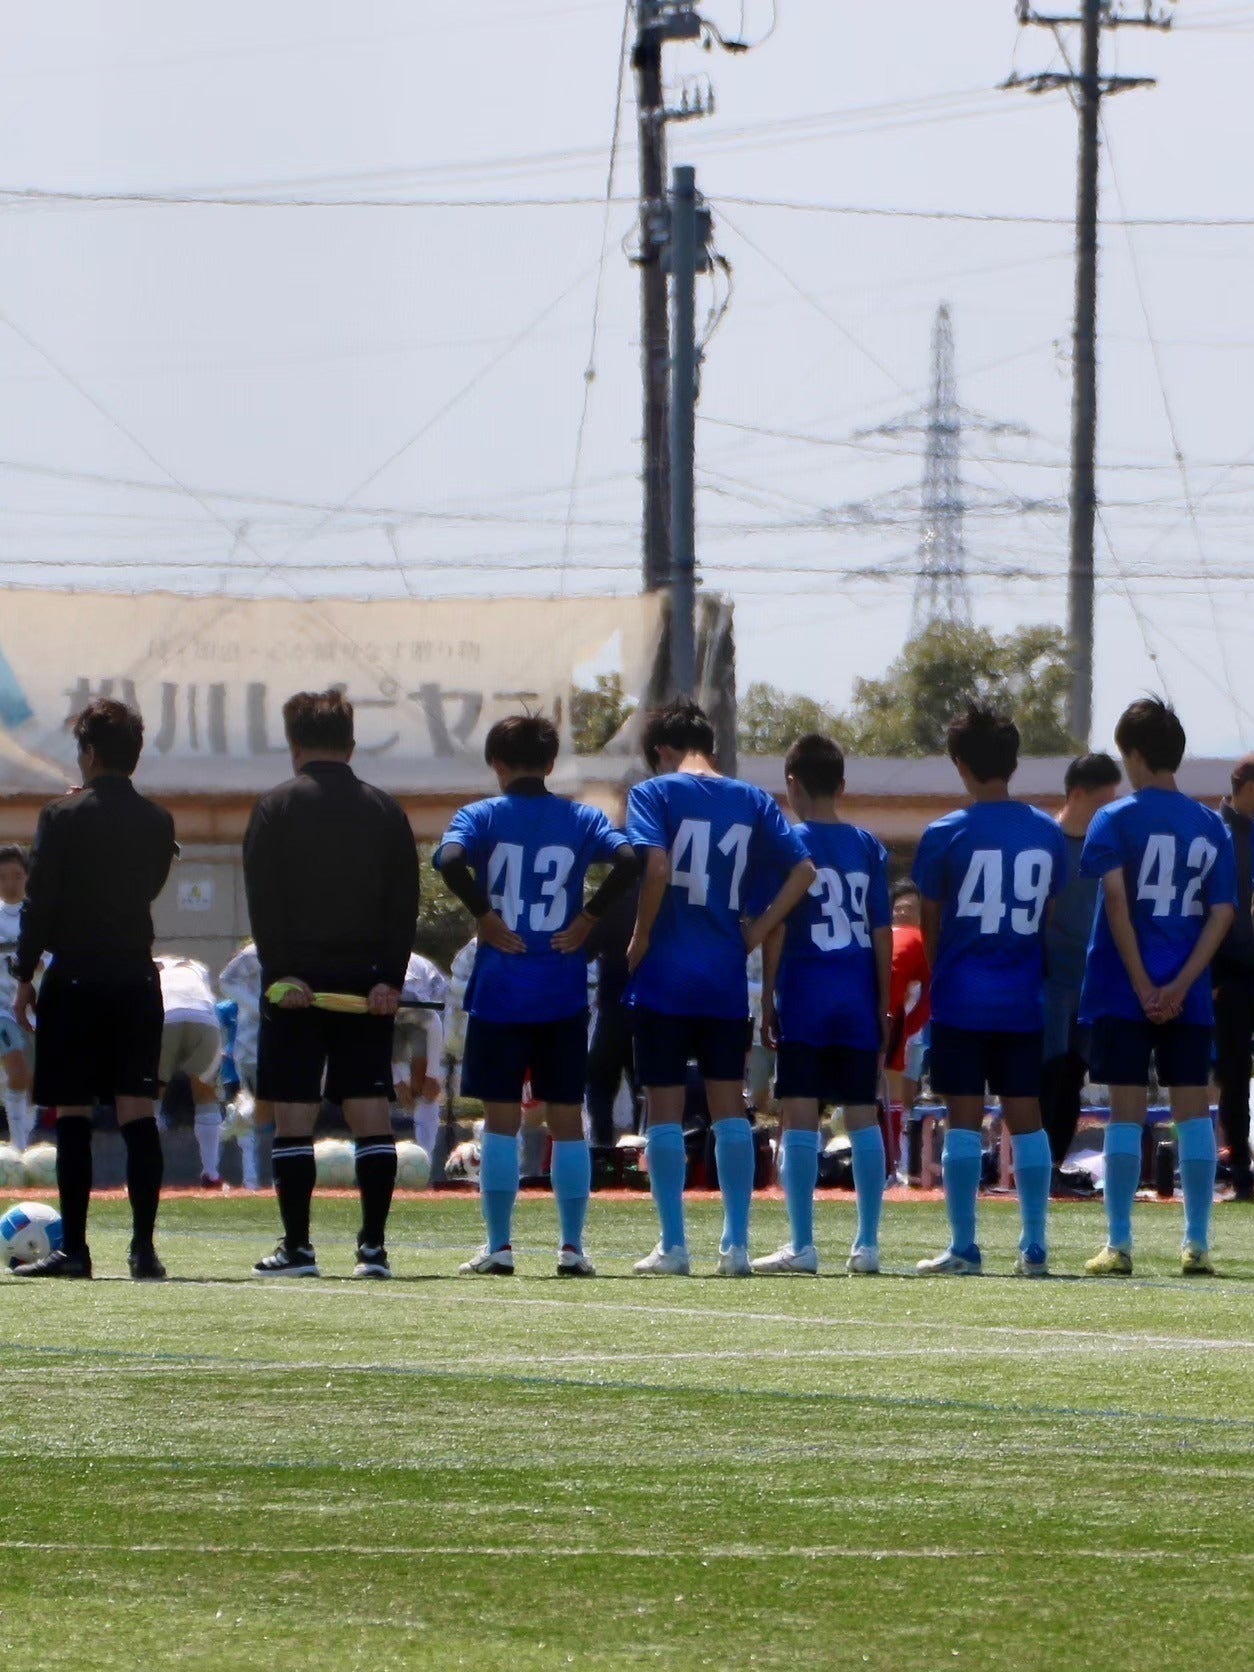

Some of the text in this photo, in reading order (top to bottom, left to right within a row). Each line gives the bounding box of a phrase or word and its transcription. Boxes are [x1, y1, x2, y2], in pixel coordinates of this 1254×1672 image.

[487, 842, 576, 932] 43
[670, 818, 752, 914] 41
[956, 849, 1054, 935] 49
[1138, 834, 1218, 917] 42
[807, 867, 872, 952] 39
